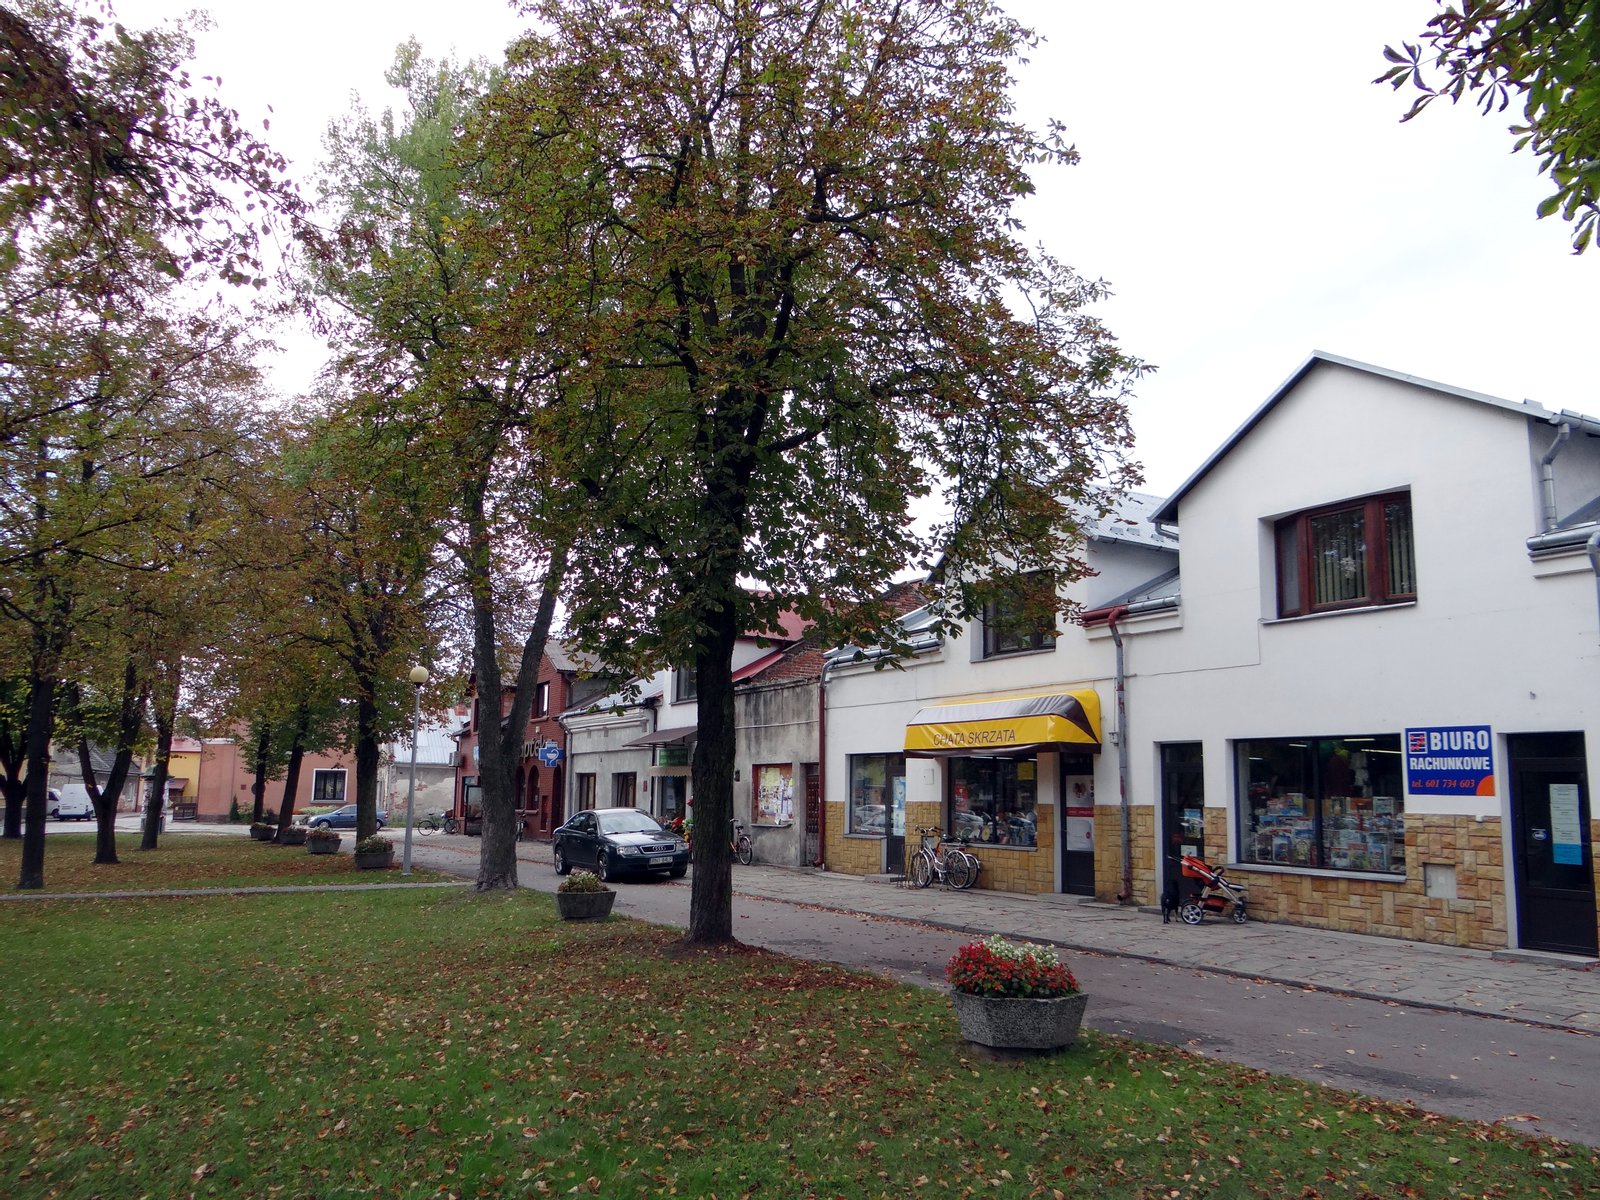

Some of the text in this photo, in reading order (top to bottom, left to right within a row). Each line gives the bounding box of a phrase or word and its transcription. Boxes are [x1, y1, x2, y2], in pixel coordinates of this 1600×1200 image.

[933, 729, 1016, 746] CHATA SKRZATA
[1430, 730, 1489, 750] BIURO
[1409, 756, 1491, 770] RACHUNKOWE
[1425, 779, 1440, 788] 601
[1442, 779, 1457, 788] 734
[1459, 779, 1475, 788] 603
